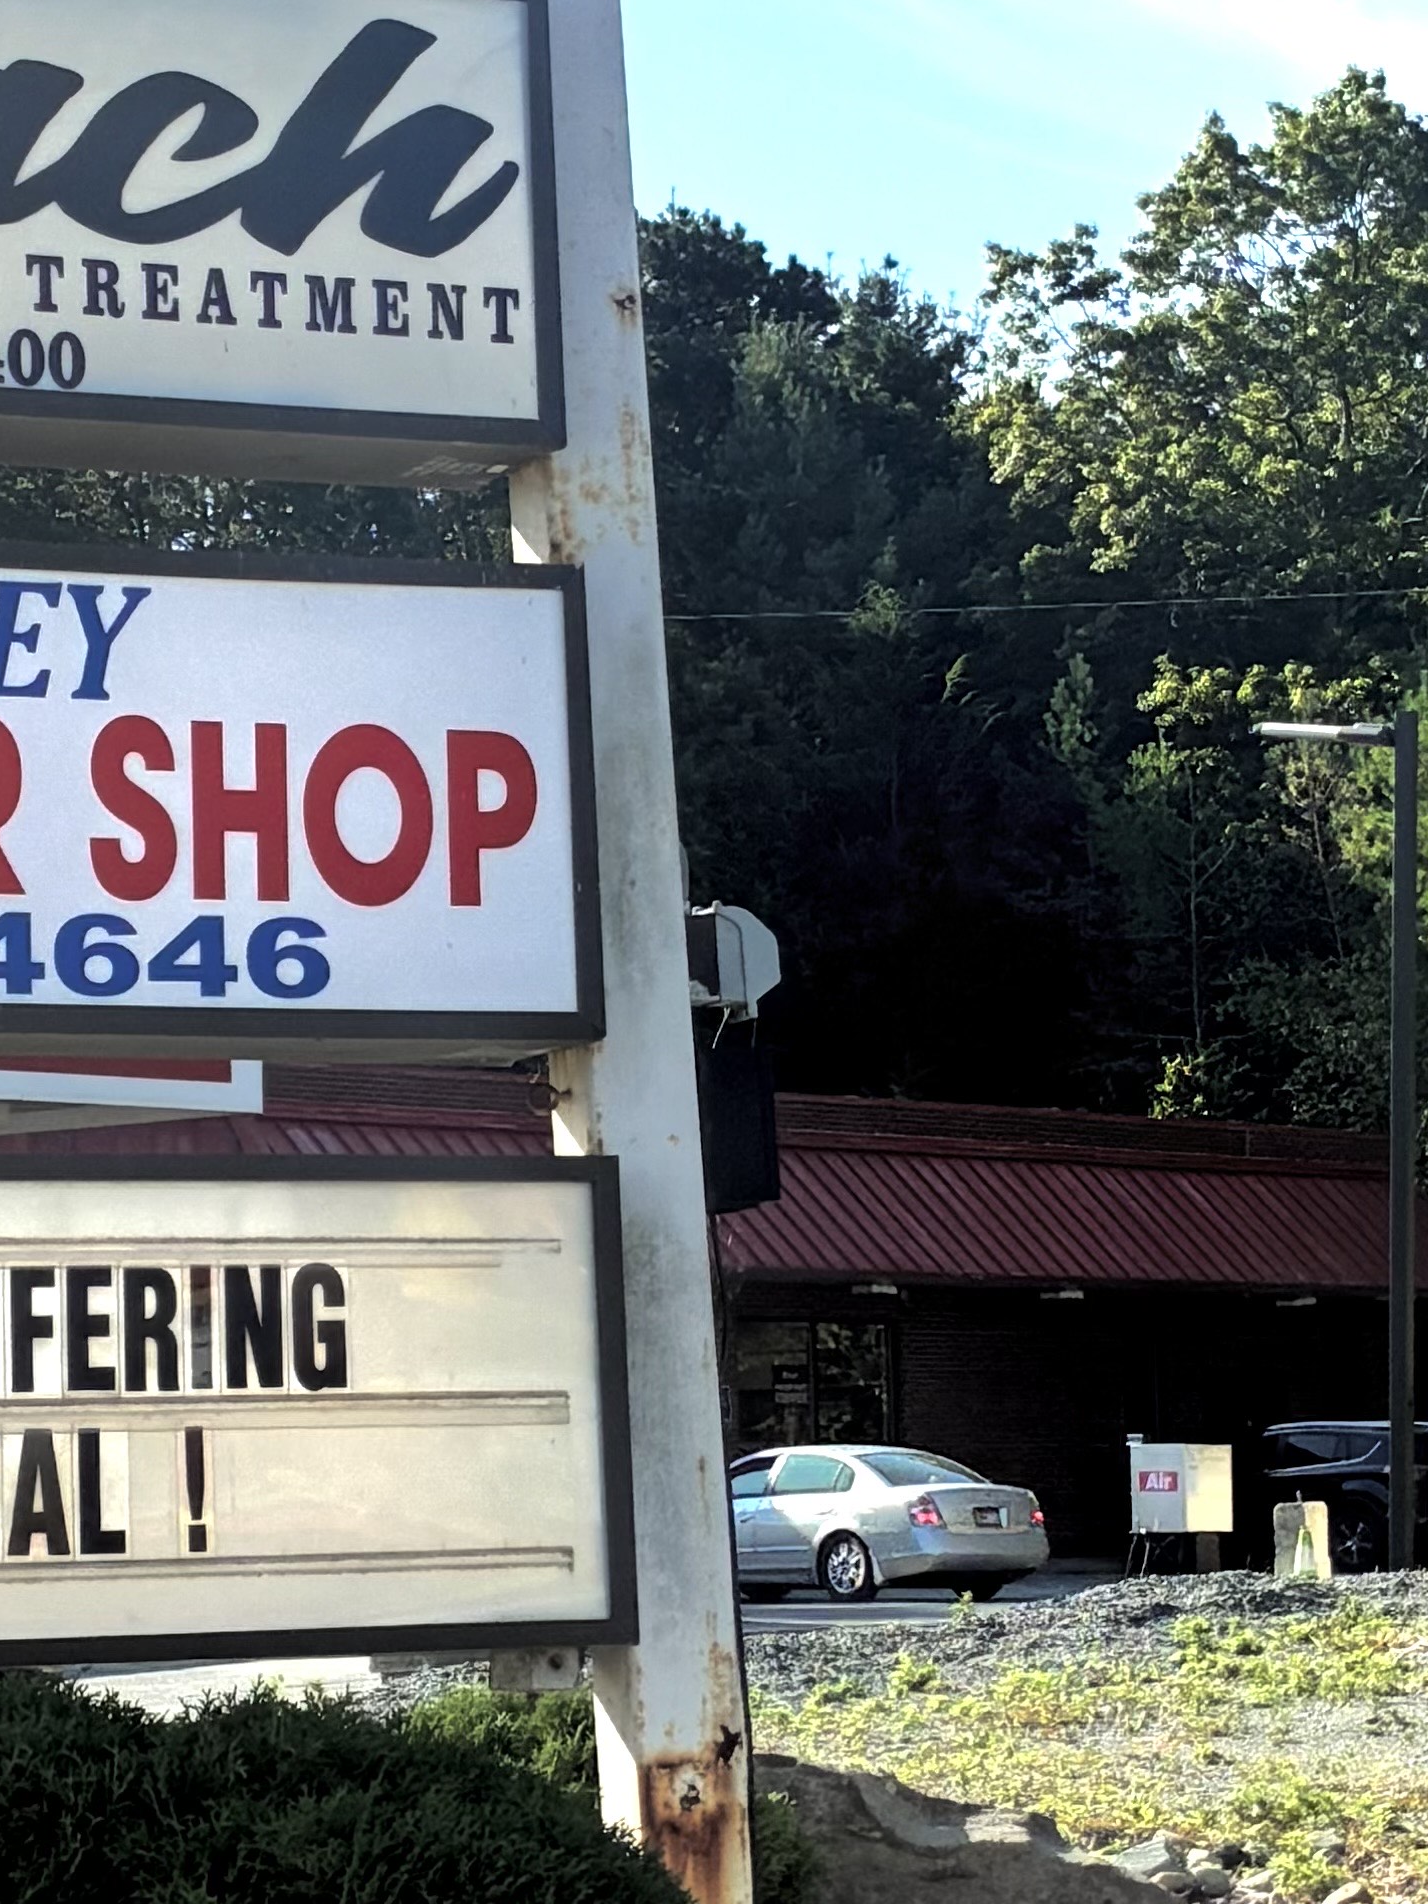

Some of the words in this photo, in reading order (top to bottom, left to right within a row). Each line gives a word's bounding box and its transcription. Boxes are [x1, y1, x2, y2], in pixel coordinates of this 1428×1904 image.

[26, 254, 522, 345] TREATMENT
[88, 715, 538, 908] SHOP
[1145, 1472, 1173, 1490] Air
